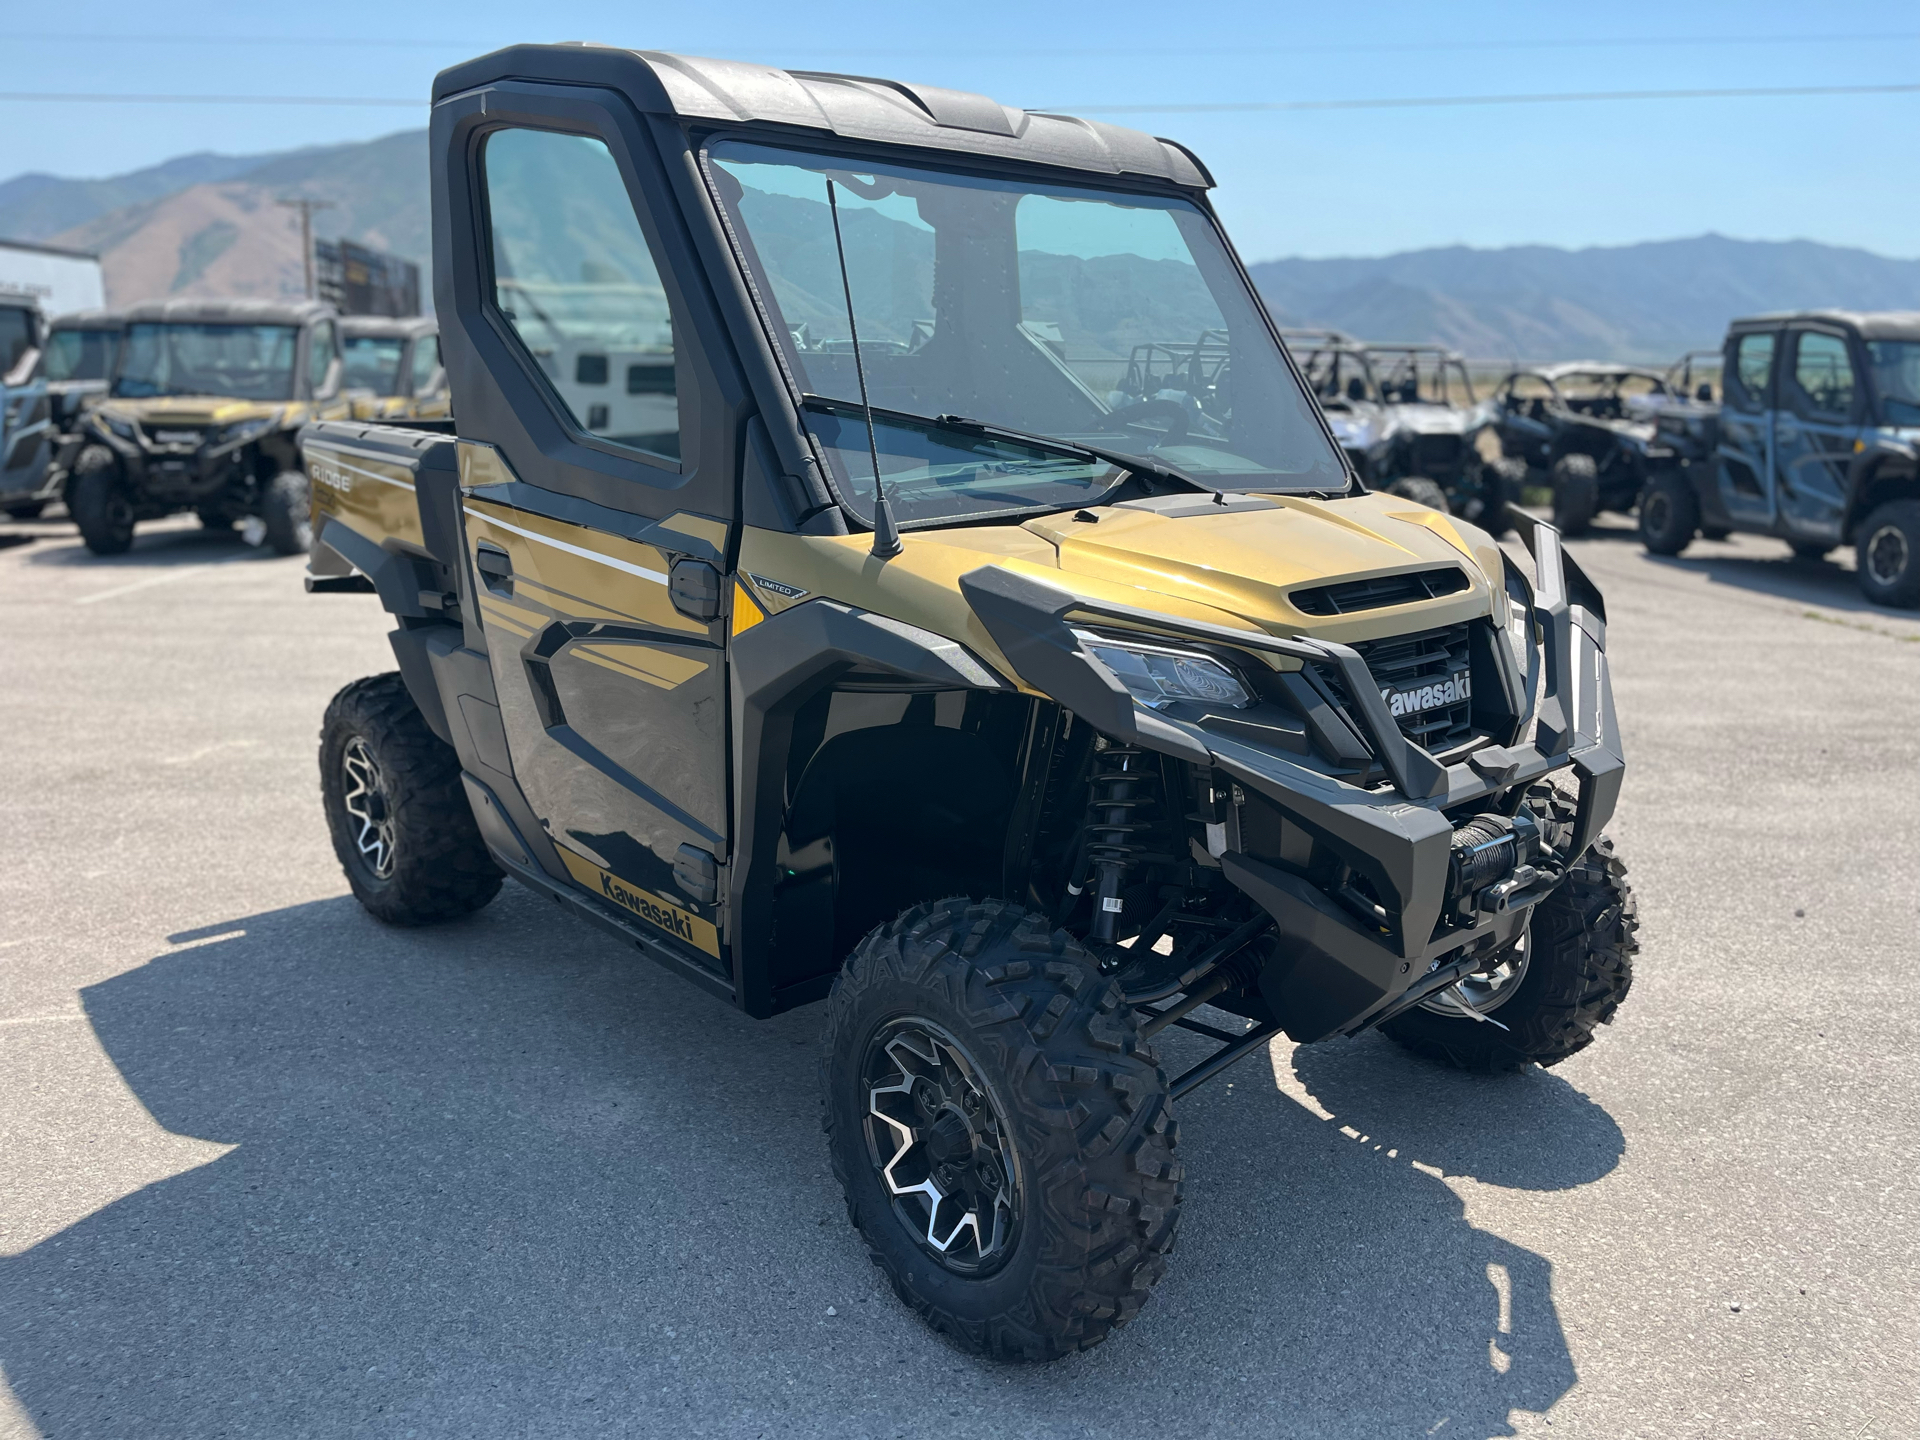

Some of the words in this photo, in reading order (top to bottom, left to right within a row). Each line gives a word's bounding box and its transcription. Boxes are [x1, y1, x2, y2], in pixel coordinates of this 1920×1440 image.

[312, 464, 351, 493] RIDGE
[759, 579, 792, 595] LIMITED
[599, 870, 694, 942] Kawasaki
